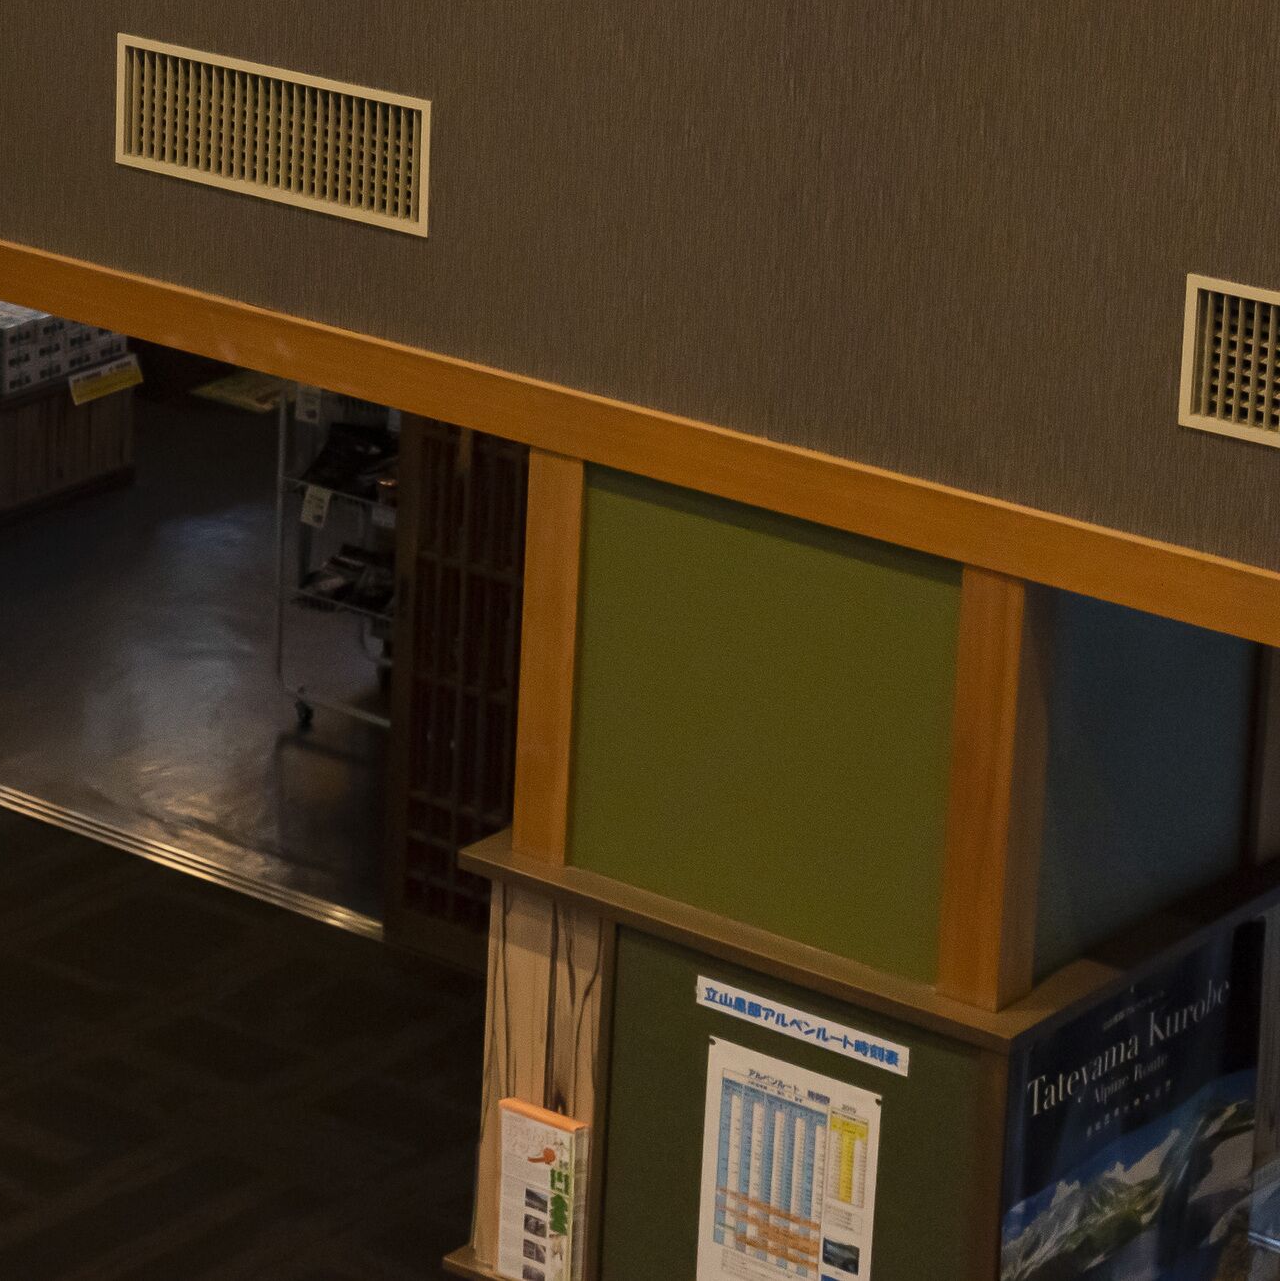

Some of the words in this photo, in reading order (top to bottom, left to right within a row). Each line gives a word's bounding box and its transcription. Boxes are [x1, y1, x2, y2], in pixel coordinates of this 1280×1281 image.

[704, 986, 900, 1067] 立山黒部アルペンルート時刻表
[1028, 1034, 1139, 1117] Tateyama
[1149, 979, 1230, 1046] Kurobe
[1093, 1073, 1129, 1106] Alpine
